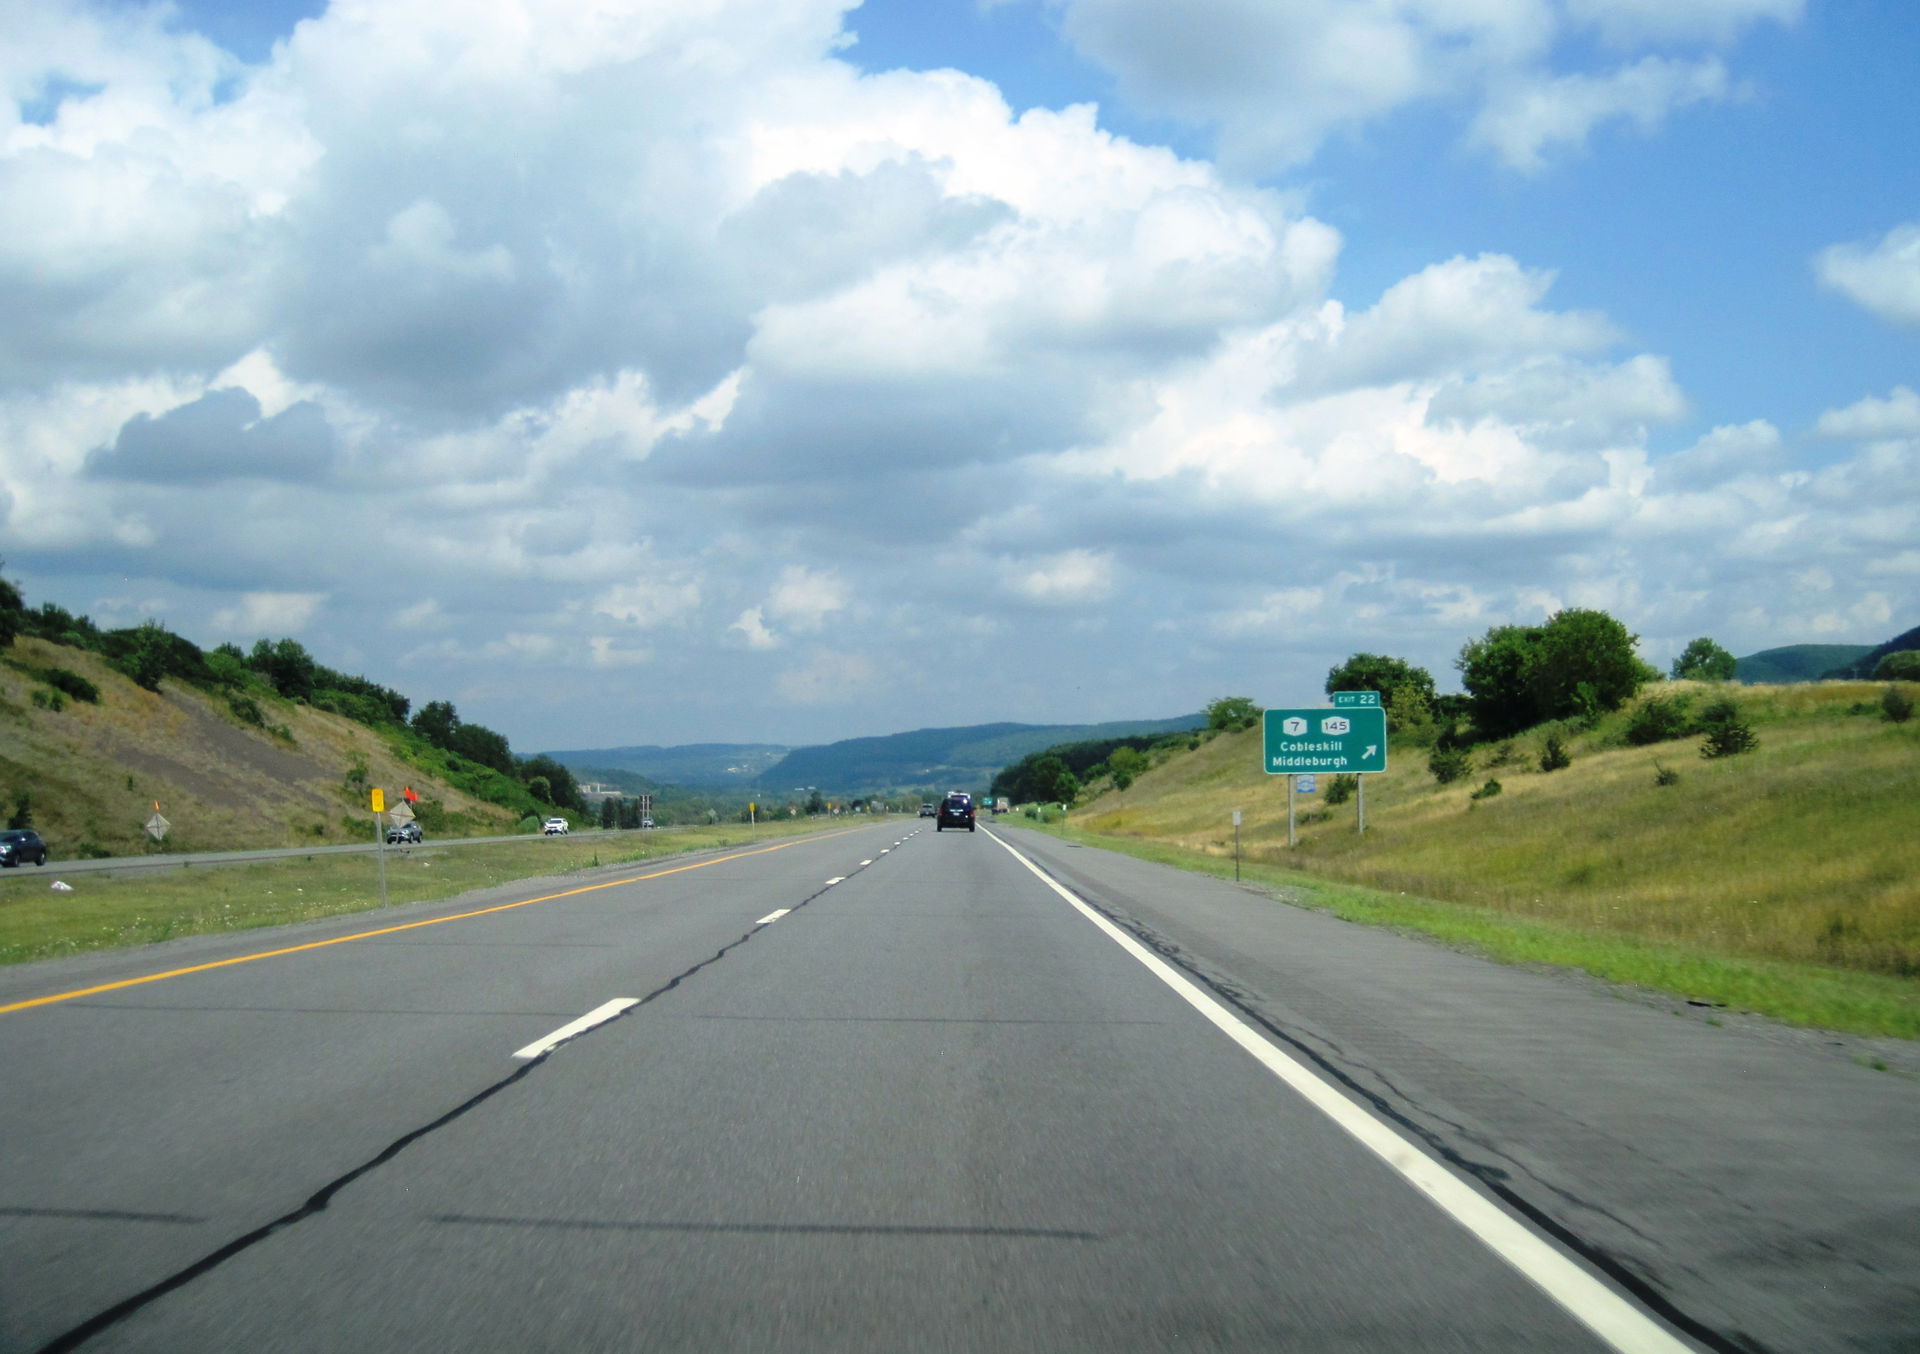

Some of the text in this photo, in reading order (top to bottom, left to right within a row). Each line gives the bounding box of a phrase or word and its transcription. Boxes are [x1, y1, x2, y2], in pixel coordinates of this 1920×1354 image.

[1359, 694, 1376, 704] 22
[1290, 721, 1347, 731] 7 145
[1280, 741, 1342, 752] Cobleskill
[1273, 756, 1348, 768] Middleburgh
